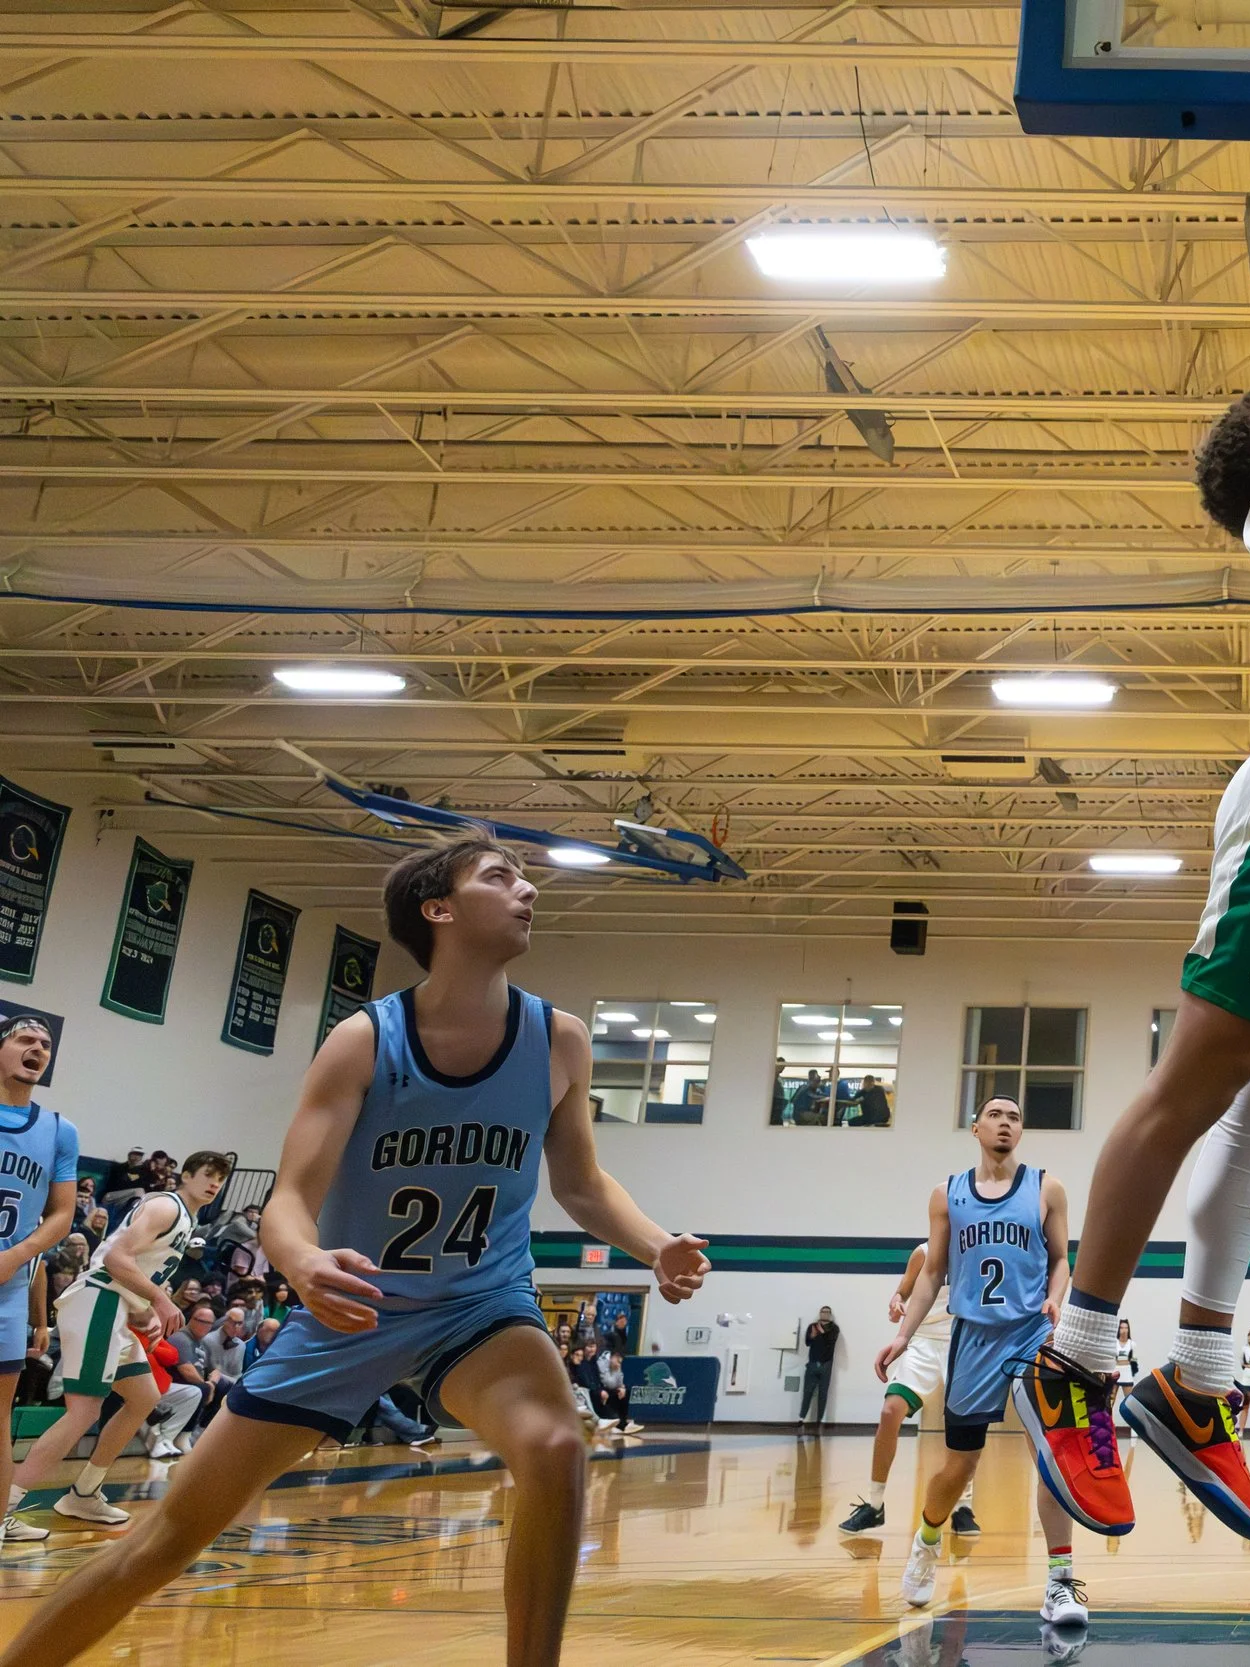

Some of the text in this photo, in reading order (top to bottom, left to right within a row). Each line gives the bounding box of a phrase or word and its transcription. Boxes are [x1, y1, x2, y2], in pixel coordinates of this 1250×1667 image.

[371, 1122, 531, 1173] GORDON
[379, 1185, 499, 1274] 24
[958, 1220, 1032, 1255] GORDON
[980, 1256, 1008, 1308] 2
